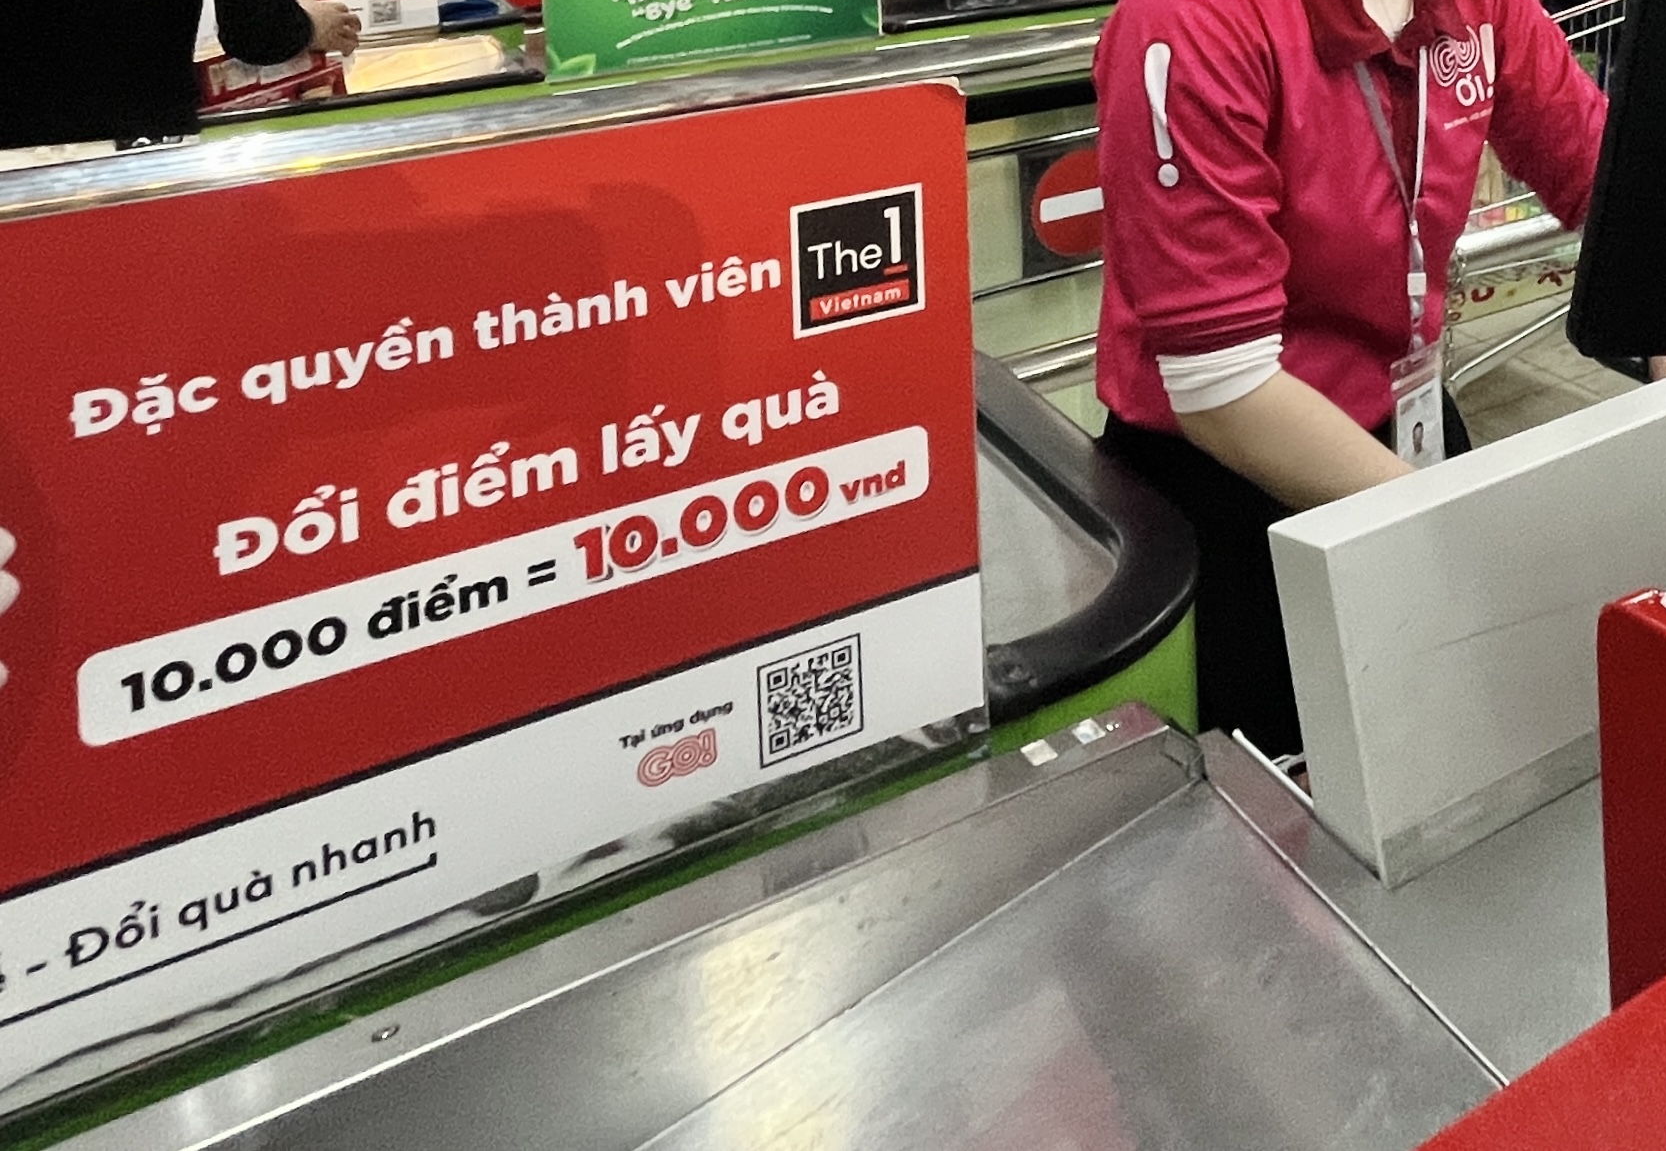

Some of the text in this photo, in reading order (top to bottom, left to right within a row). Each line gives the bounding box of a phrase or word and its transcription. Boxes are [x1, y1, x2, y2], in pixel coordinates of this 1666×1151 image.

[68, 252, 783, 440] Đặc quyền thành viên
[818, 282, 904, 317] Vietnam
[212, 374, 843, 578] Đổi điểm lấy quà
[120, 458, 909, 714] 10.000 điểm 10.000 vnd
[618, 700, 734, 750] Tại ứng dụng
[636, 726, 719, 789] GO!
[64, 811, 439, 969] Đổi quà nhanh
